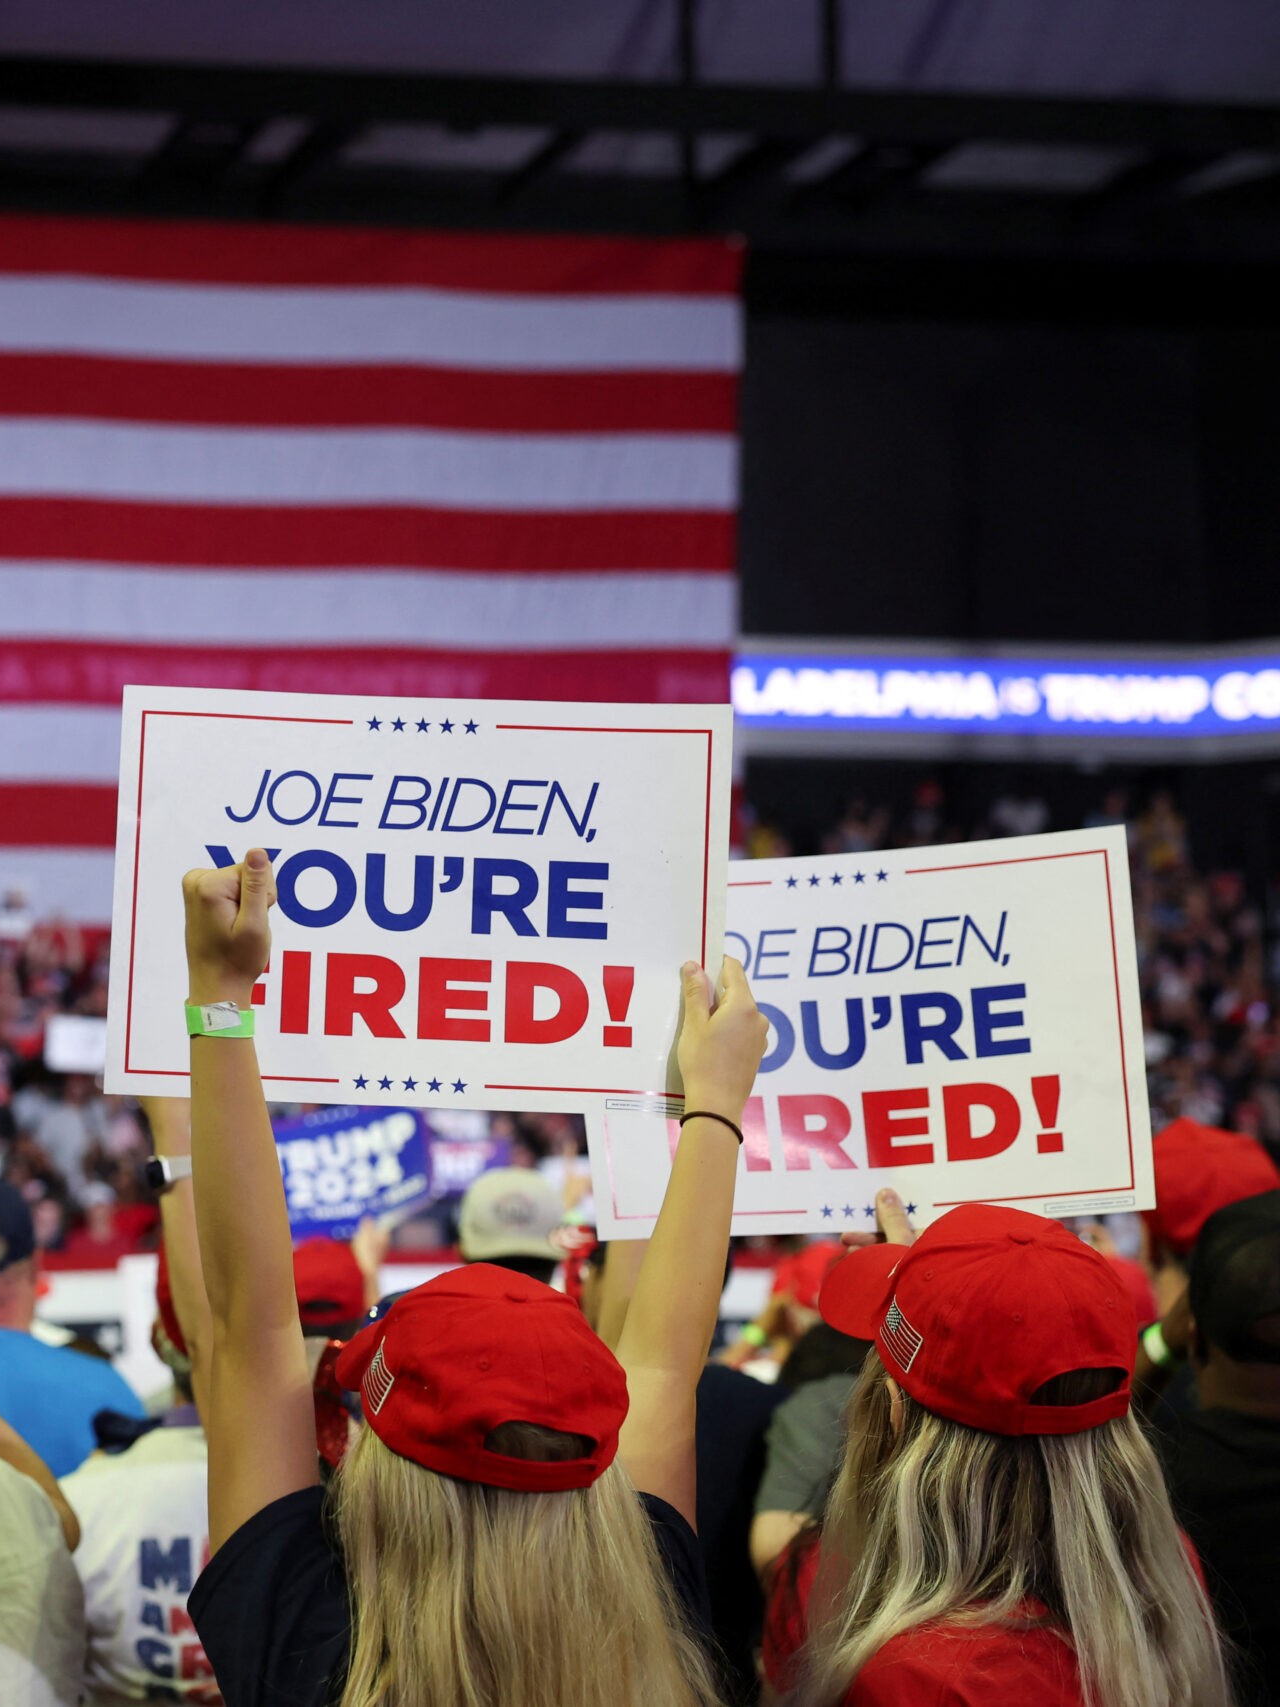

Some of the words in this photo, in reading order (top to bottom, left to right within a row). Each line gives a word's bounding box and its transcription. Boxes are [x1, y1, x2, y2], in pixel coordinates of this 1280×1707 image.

[224, 768, 374, 829] JOE
[378, 774, 600, 844] BIDEN,
[807, 911, 1010, 979] BIDEN,
[251, 950, 636, 1049] IRED!
[276, 1112, 416, 1171] RUMP
[668, 1074, 1065, 1173] IRED!
